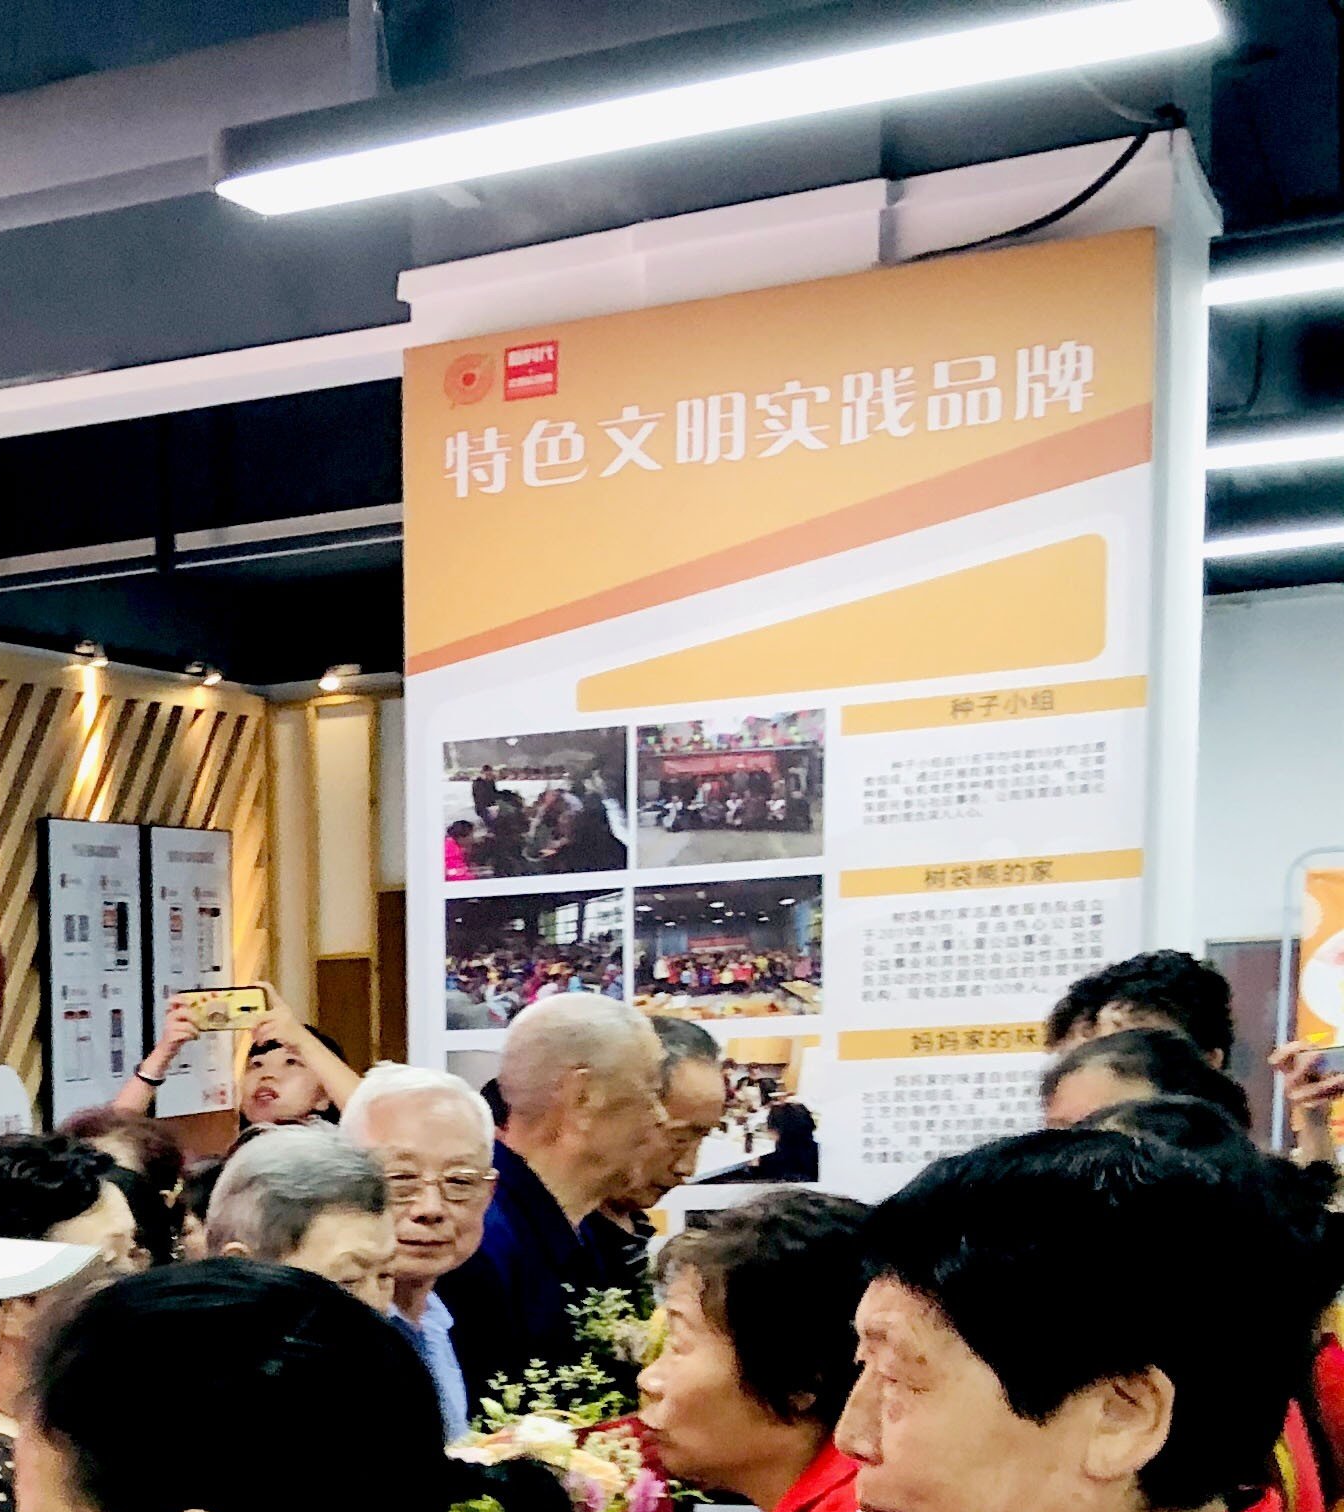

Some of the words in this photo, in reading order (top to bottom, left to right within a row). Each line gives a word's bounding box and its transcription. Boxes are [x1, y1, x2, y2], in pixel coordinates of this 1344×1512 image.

[444, 339, 1095, 499] 特色文明实践品牌
[950, 688, 1055, 720] 种子小组
